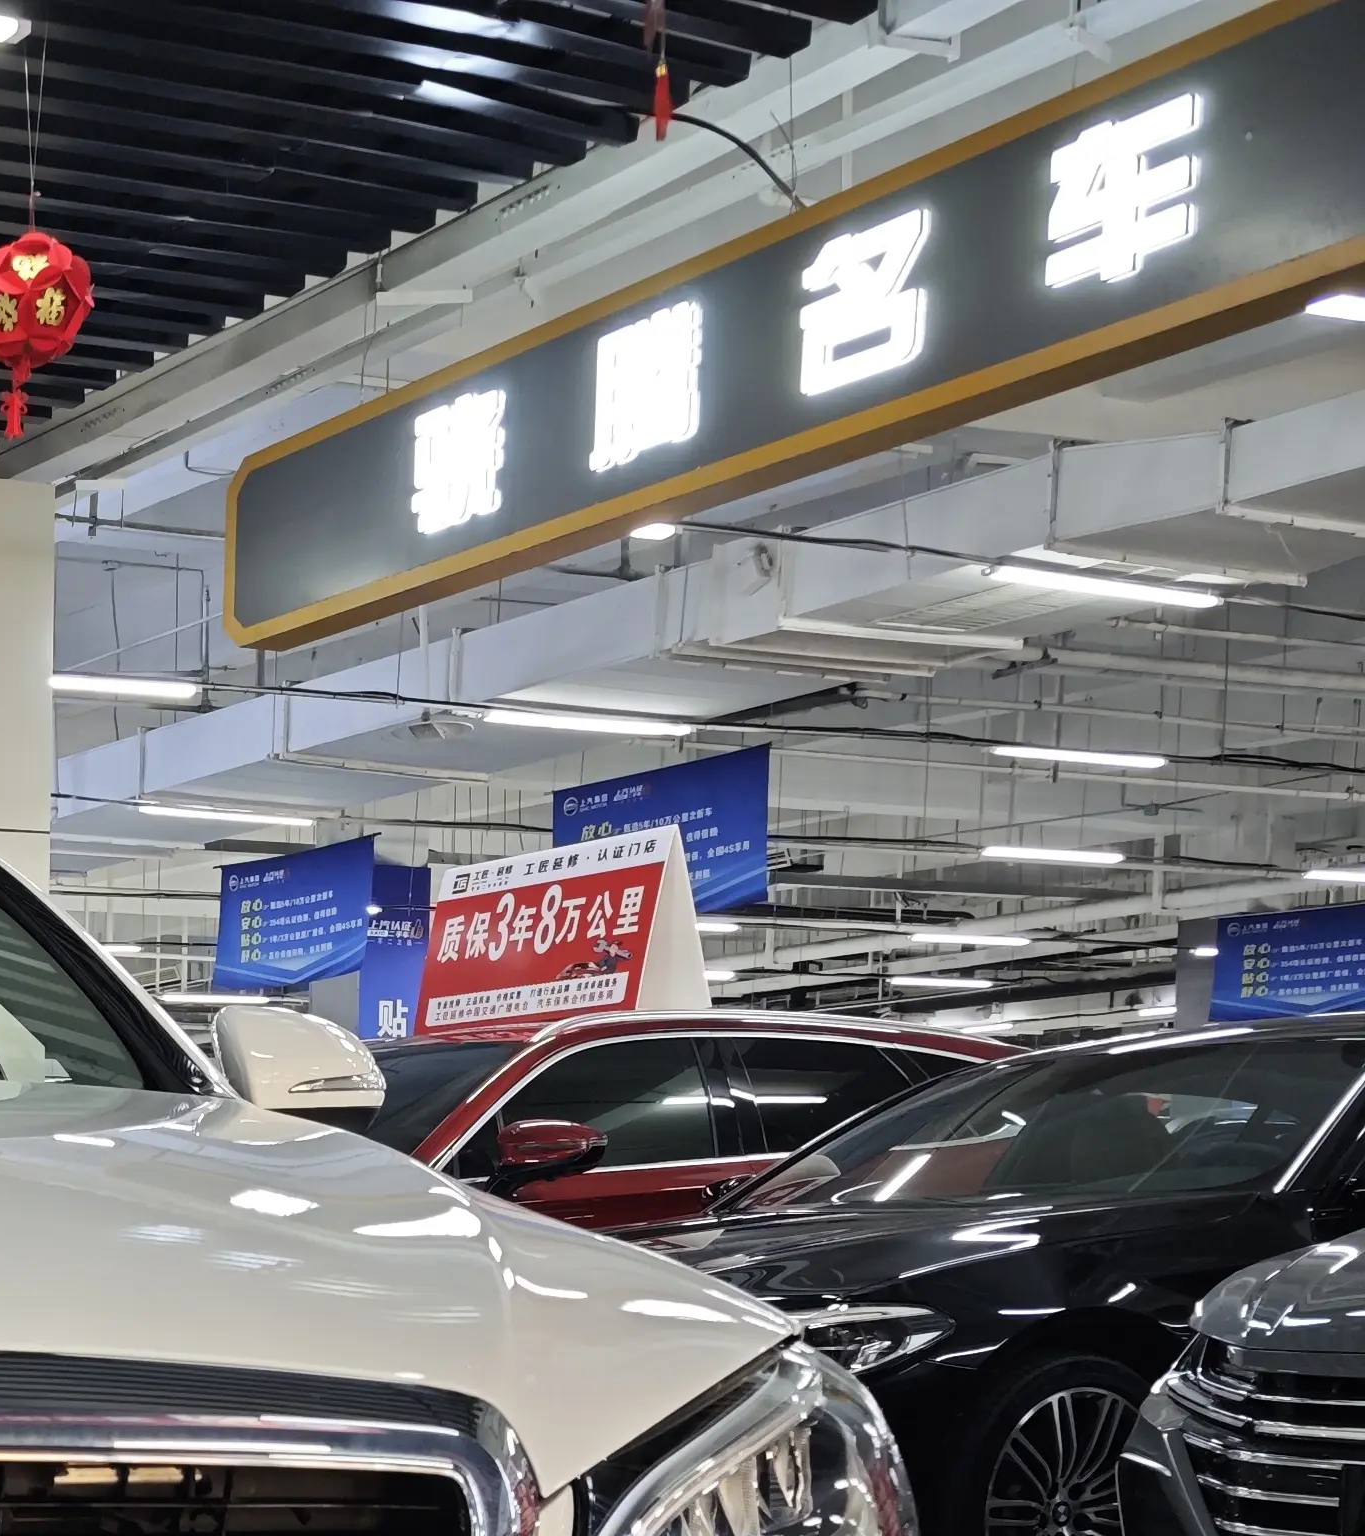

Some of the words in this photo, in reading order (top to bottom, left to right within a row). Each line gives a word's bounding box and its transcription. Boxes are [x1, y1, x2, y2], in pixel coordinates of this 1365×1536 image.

[411, 90, 1204, 538] 名车
[581, 821, 612, 841] 放心
[436, 884, 645, 963] 质保3年8万公里
[377, 999, 408, 1037] 贴
